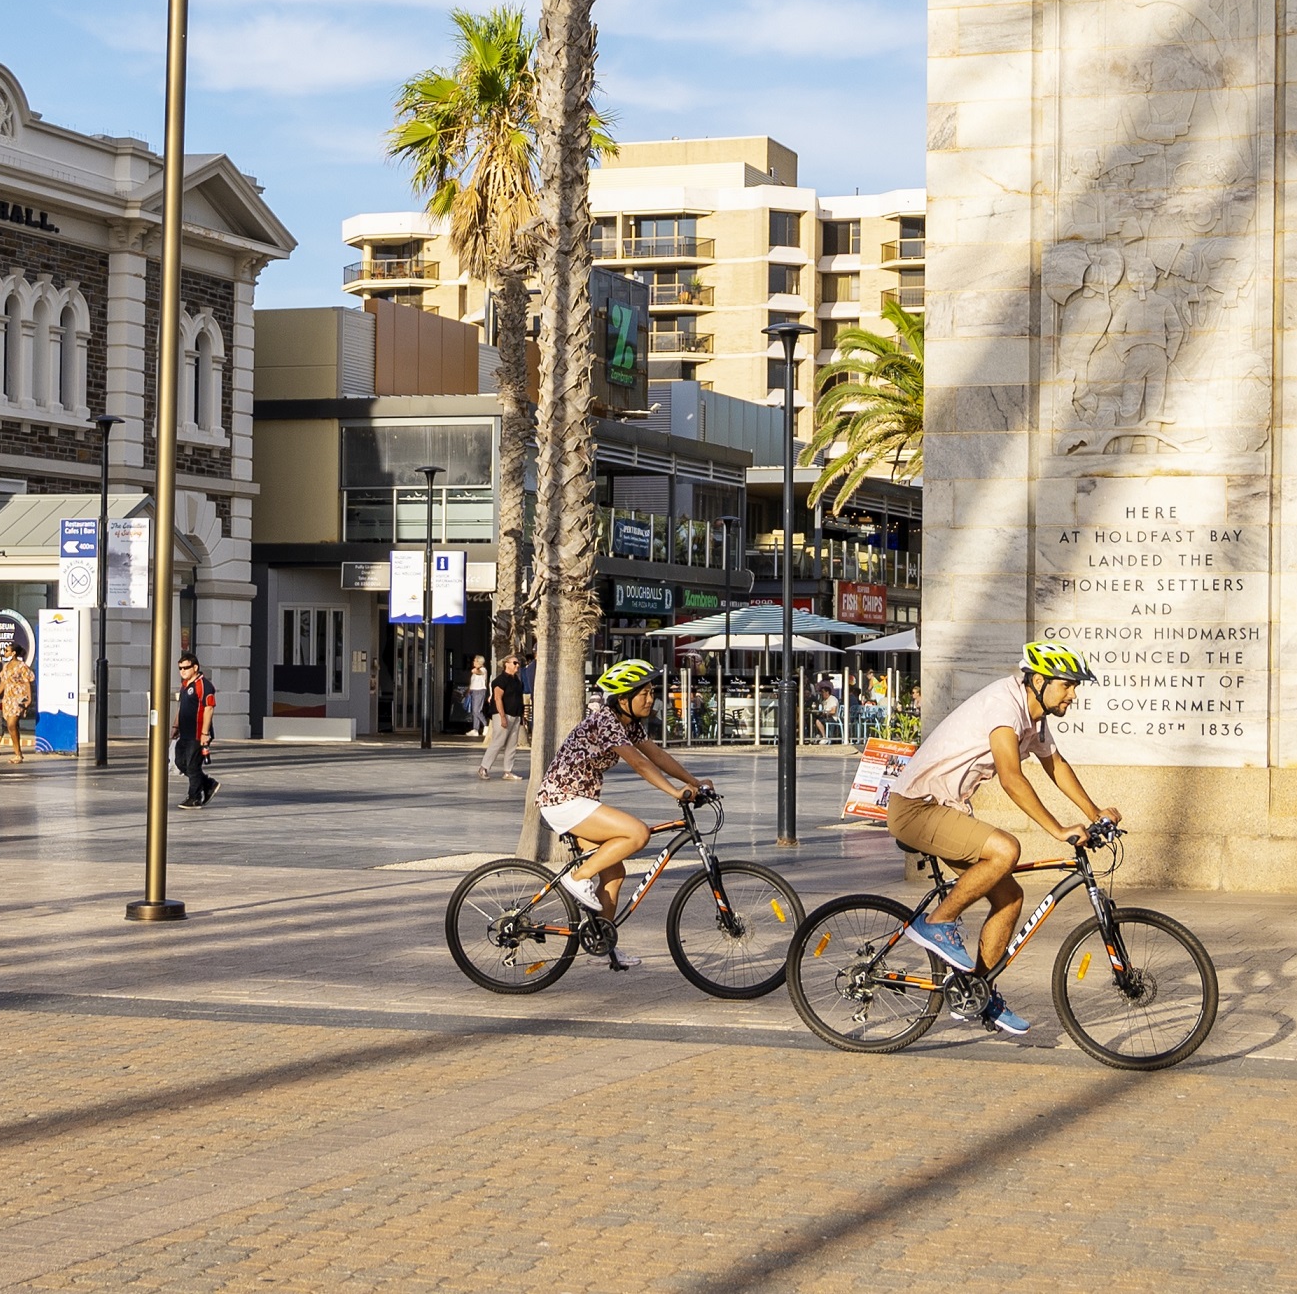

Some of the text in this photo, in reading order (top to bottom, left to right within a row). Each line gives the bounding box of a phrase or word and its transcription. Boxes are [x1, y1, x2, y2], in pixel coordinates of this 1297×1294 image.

[1126, 506, 1178, 519] HERE
[65, 520, 96, 528] Restaurants
[83, 527, 96, 535] Bars
[110, 522, 122, 530] The
[114, 530, 120, 538] of
[1059, 529, 1243, 544] AT HOLDFAST BAY
[1088, 553, 1214, 567] LANDED THE
[1062, 578, 1244, 592] PIONEER SETTLERS
[626, 585, 663, 600] DOUGHBALLS
[684, 589, 718, 608] Zambrero
[842, 593, 883, 613] FISH CHIPS
[1131, 603, 1173, 615] AND
[1044, 626, 1260, 640] GOVERNOR HINDMARSH
[1082, 651, 1244, 664] NOUNCED THE
[1083, 675, 1245, 688] ABLISHMENT OF
[1069, 698, 1245, 712] HE GOVERNMENT
[1057, 721, 1084, 734] ON
[1098, 721, 1137, 735] DEC.
[1200, 722, 1244, 737] 1836
[631, 848, 669, 902] FLUID
[1007, 893, 1054, 956] FLUID
